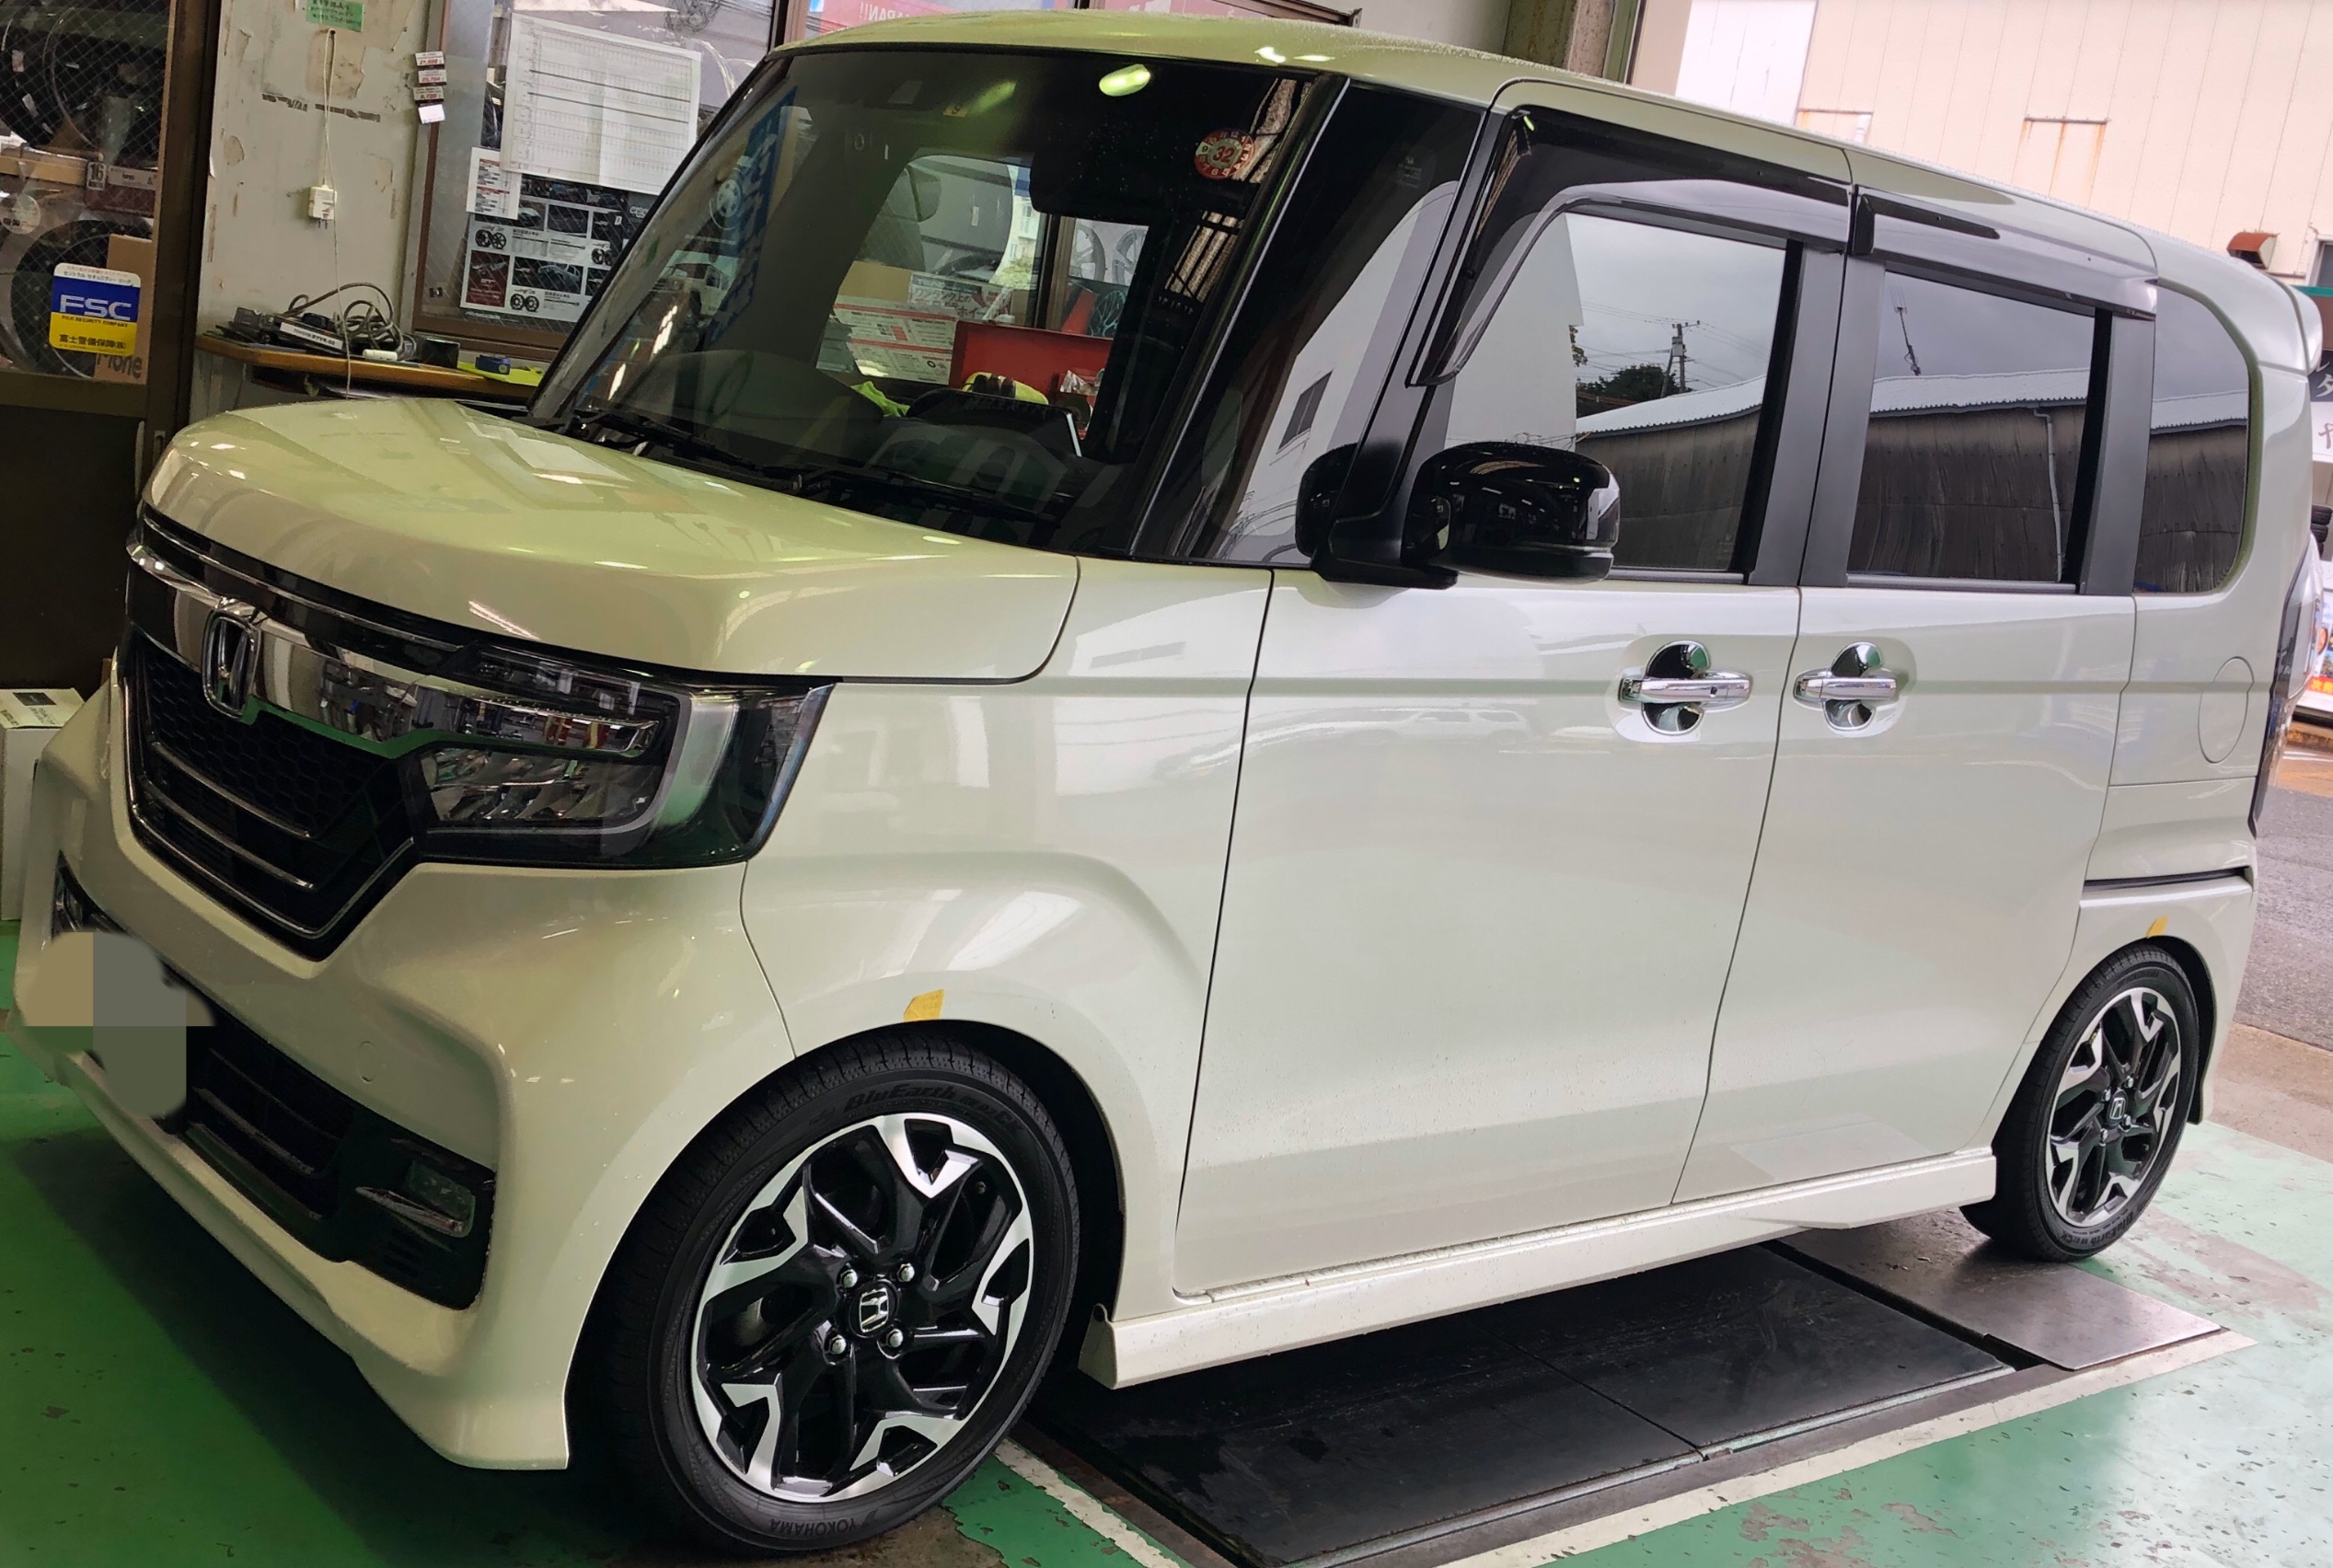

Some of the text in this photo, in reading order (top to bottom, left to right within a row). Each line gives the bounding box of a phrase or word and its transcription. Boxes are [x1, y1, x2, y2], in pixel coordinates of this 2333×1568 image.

[1213, 146, 1235, 162] 32
[90, 164, 104, 181] 16
[60, 294, 132, 320] FSC
[843, 1083, 957, 1113] BluEarth
[770, 1518, 855, 1537] YOKOHAMA
